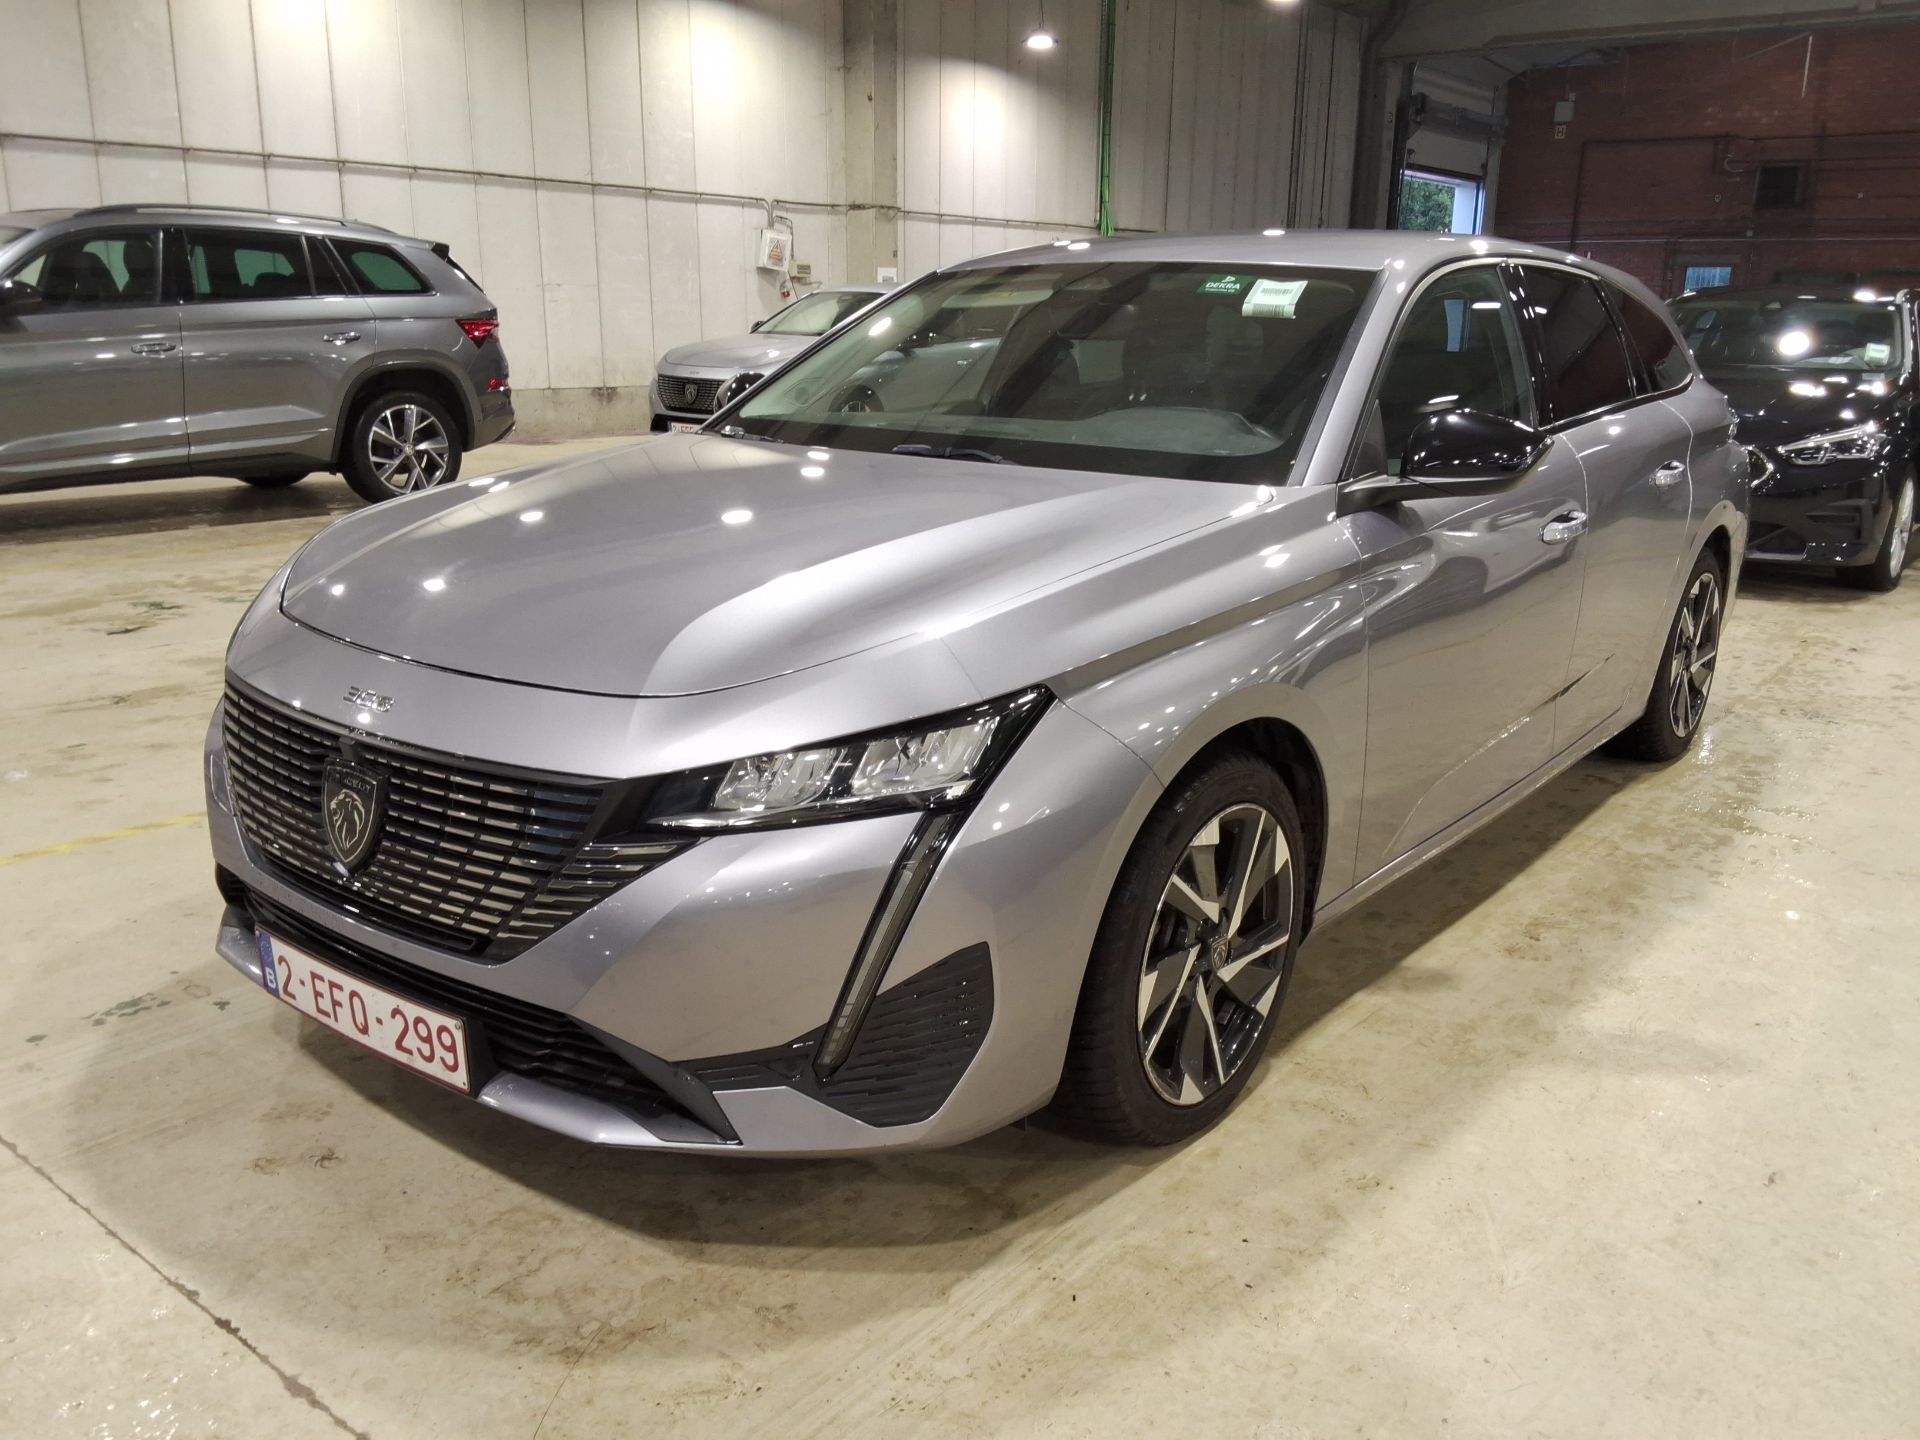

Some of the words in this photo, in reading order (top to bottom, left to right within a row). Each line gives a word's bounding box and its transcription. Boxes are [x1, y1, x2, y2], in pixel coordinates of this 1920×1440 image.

[1205, 282, 1240, 290] DEKRA
[265, 967, 277, 989] B
[278, 955, 459, 1073] 2-EFQ-299
